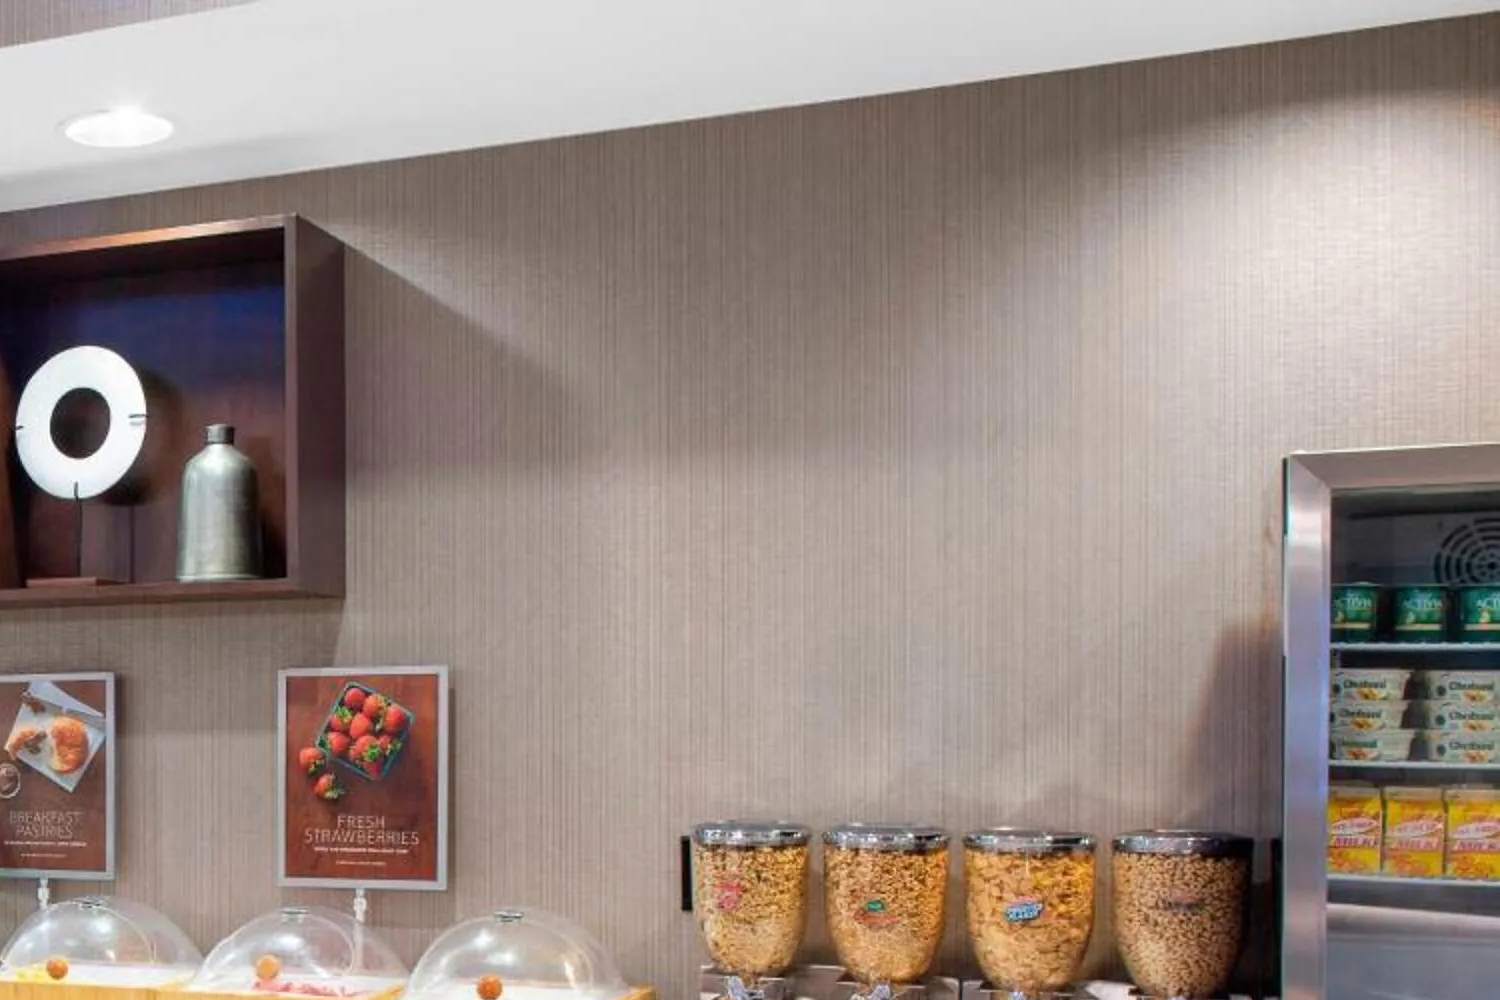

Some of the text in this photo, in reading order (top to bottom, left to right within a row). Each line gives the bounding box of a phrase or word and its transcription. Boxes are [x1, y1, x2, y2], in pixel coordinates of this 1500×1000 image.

[9, 810, 83, 824] BREAKFAST
[337, 815, 385, 829] FRESH
[16, 825, 73, 839] PASTRIES
[303, 828, 420, 845] STRAWBERRIES
